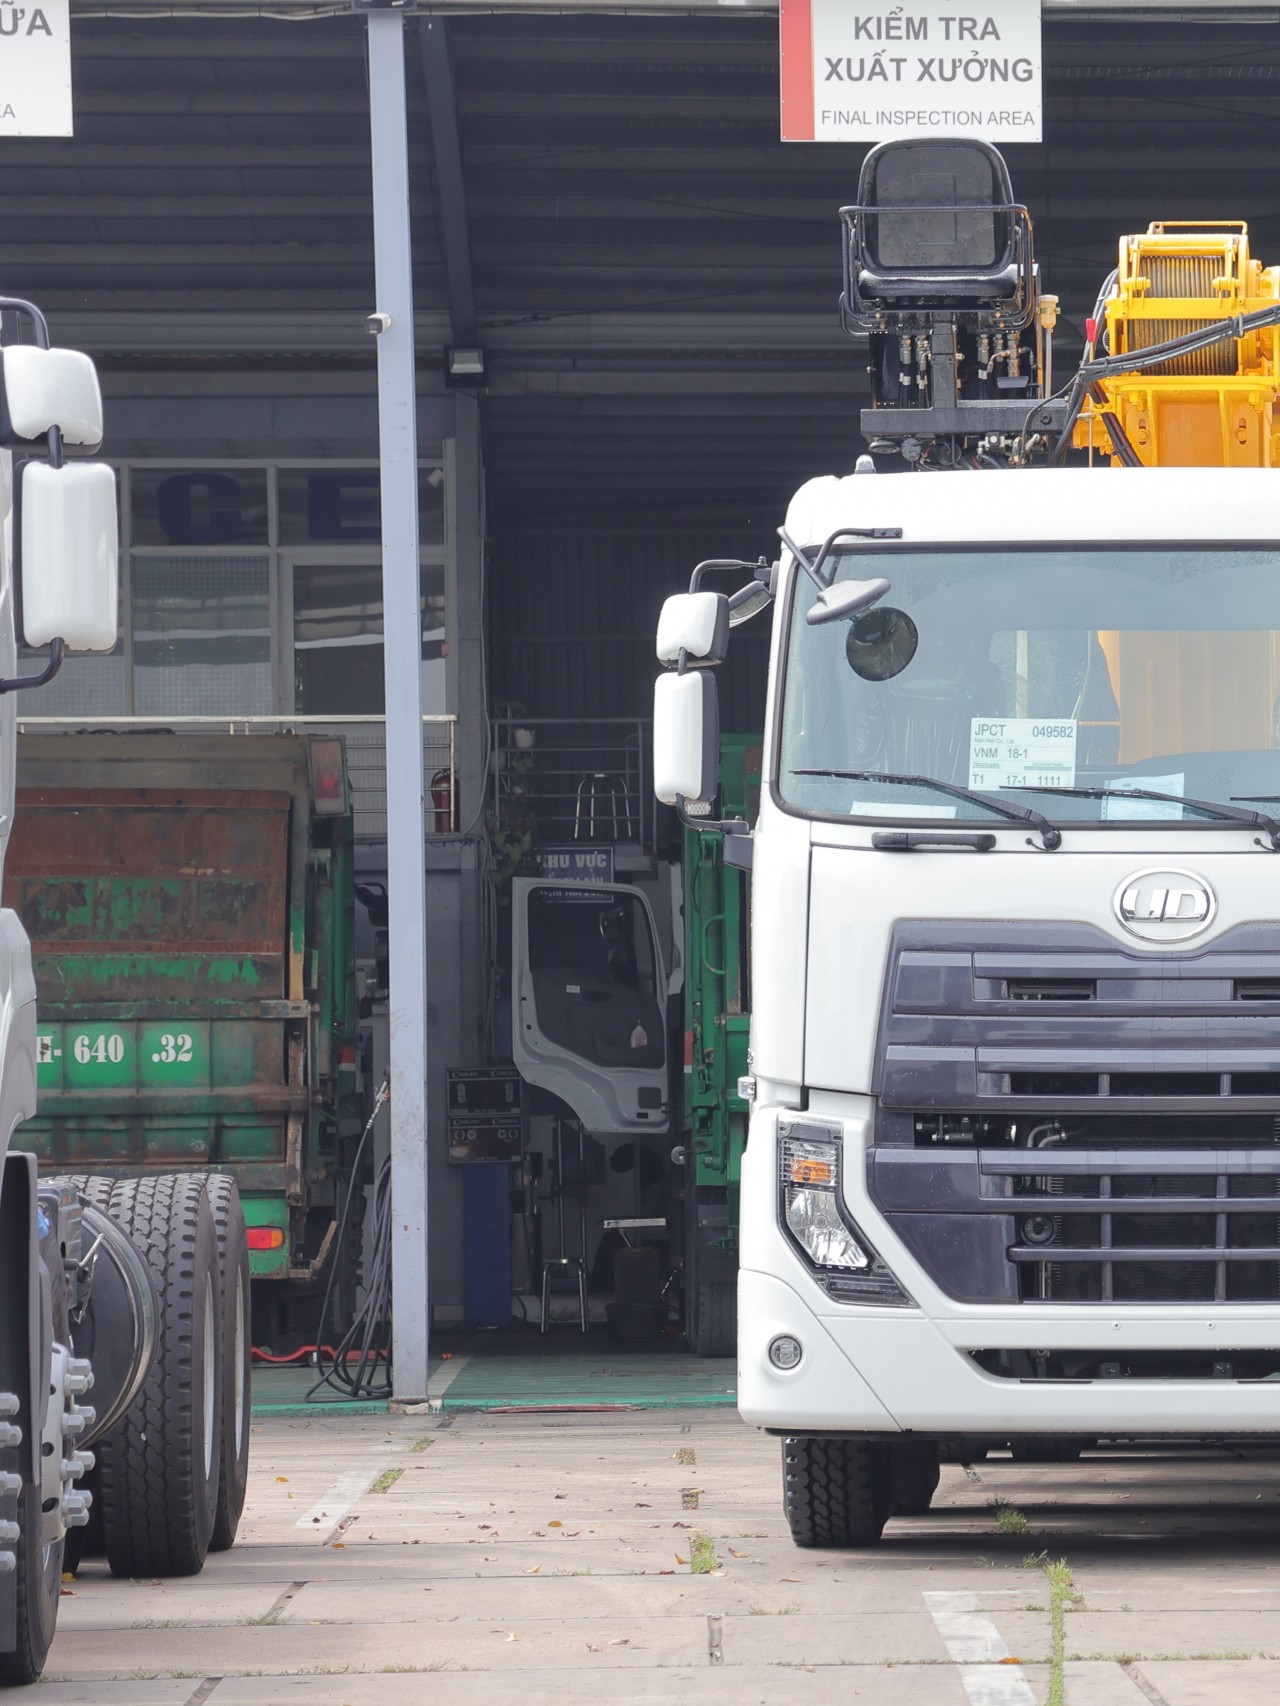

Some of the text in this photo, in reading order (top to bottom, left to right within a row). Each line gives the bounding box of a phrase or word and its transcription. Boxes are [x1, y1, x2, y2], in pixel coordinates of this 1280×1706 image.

[854, 7, 1001, 41] KIỂM TRA
[824, 49, 1034, 82] XUẤT XƯỞNG
[822, 110, 1035, 126] FINAL INSPECTION AREA
[974, 723, 1074, 738] JPCT 049582
[973, 747, 1028, 759] VNM 18-1
[972, 774, 1061, 786] T1 17-1 1111
[1121, 888, 1208, 923] UD
[73, 1034, 125, 1064] 640
